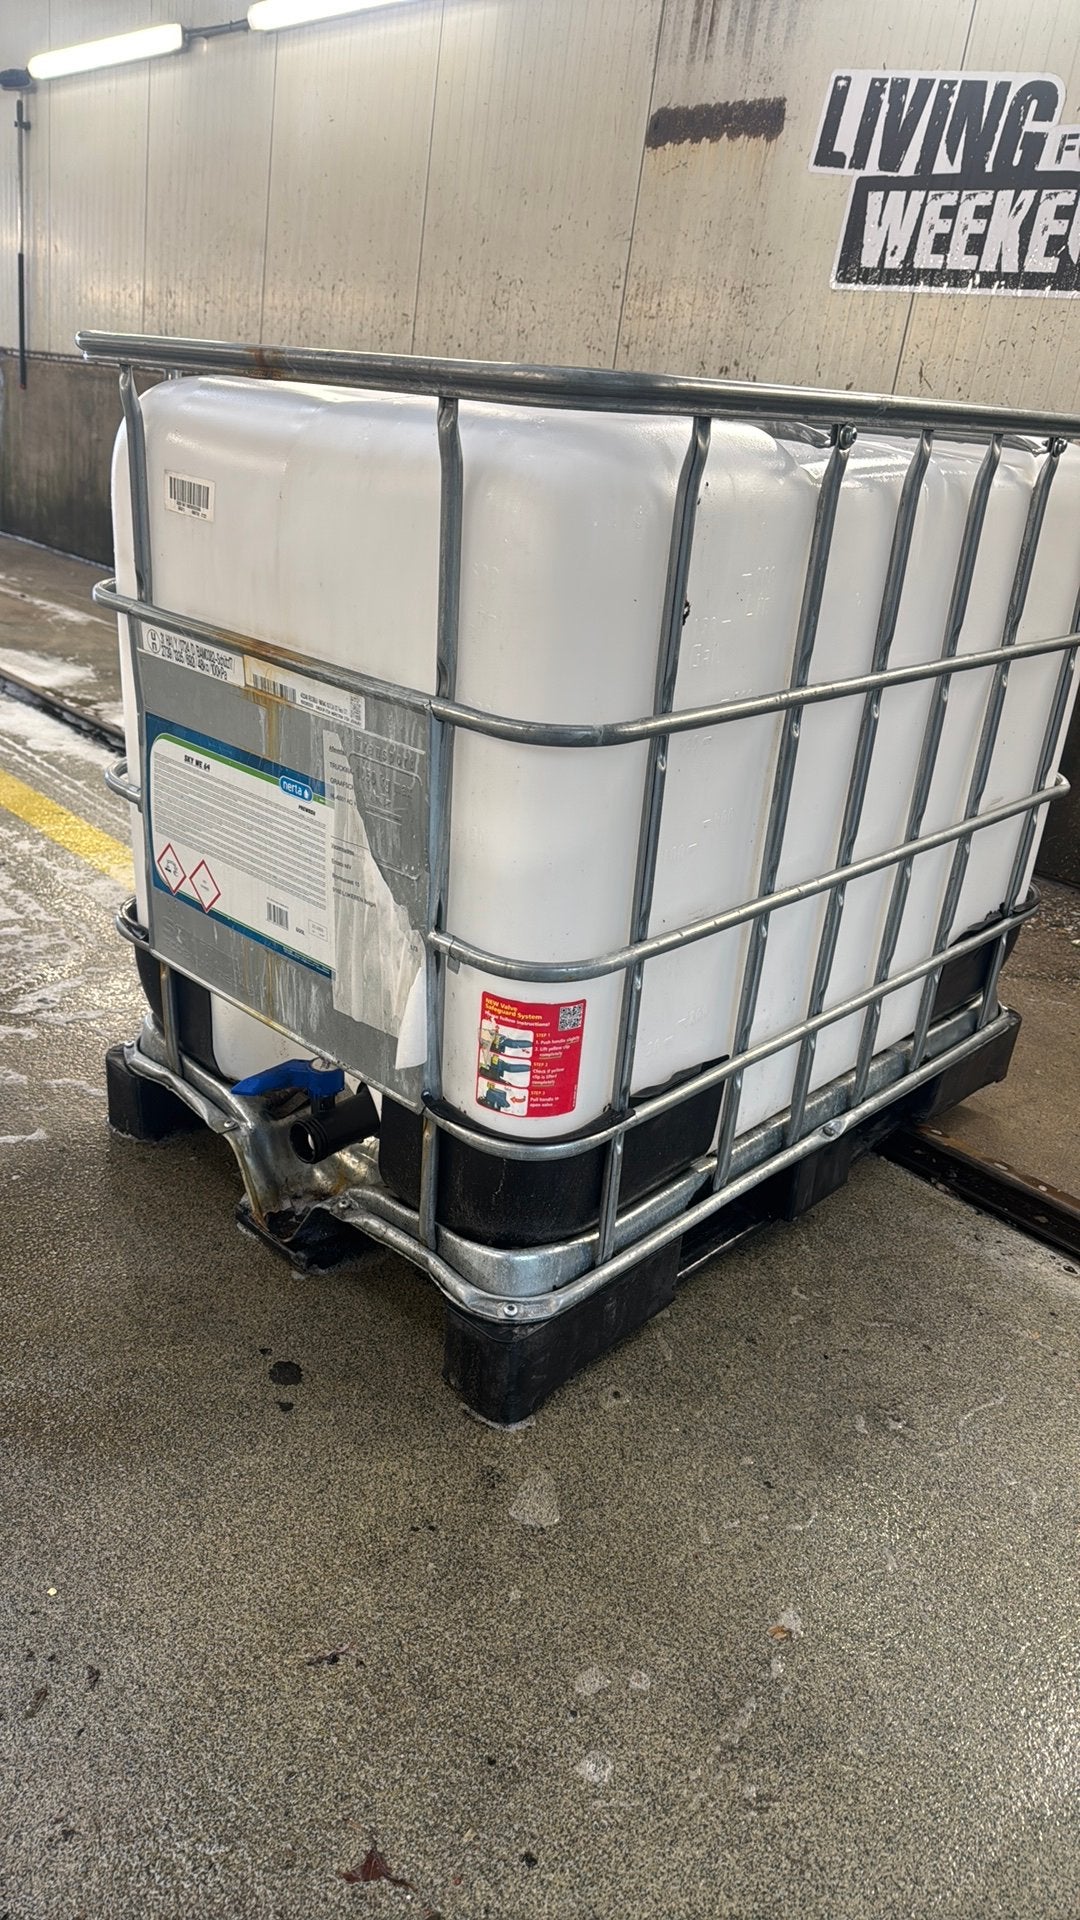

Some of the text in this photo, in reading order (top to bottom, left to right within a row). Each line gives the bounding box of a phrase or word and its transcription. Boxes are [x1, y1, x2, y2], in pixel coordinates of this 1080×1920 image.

[813, 76, 1080, 175] LIVING F
[282, 780, 303, 796] nerta
[485, 998, 518, 1012] NEW Valve
[485, 1004, 542, 1020] Safeguard System
